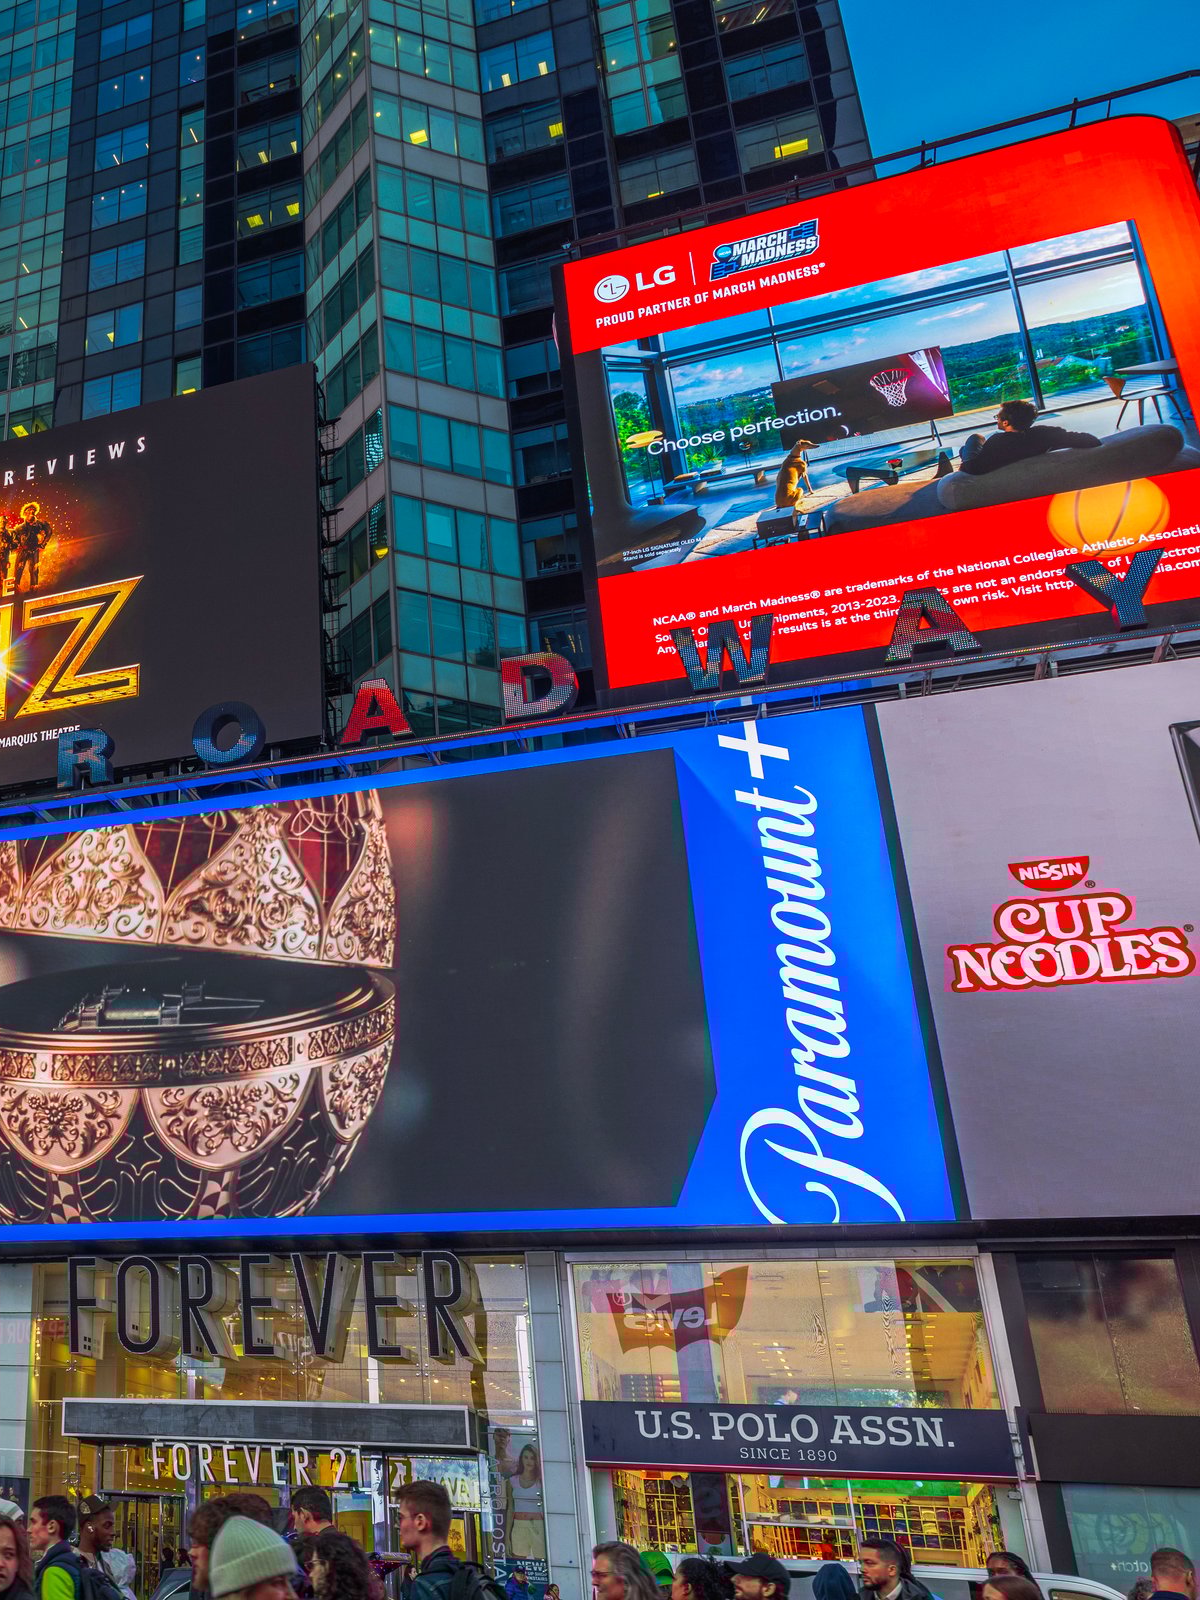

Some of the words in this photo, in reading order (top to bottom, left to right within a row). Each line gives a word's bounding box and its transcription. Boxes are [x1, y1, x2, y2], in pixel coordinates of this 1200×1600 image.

[732, 230, 788, 256] MARCH
[740, 236, 818, 267] MADNESS
[635, 265, 677, 291] LG
[595, 309, 635, 329] PROUD
[637, 296, 692, 322] PARTNER
[694, 292, 709, 305] OF
[712, 281, 757, 300] MARCH
[647, 428, 725, 456] Choose
[730, 405, 842, 442] perfection.
[698, 606, 719, 618] and
[721, 600, 758, 615] March
[823, 586, 843, 598] are
[845, 575, 914, 593] trademarks
[916, 569, 931, 581] of
[932, 567, 955, 578] the
[957, 555, 1011, 574] National
[1013, 546, 1079, 564] Collegiate
[1081, 536, 1135, 554] Athletic
[1137, 524, 1200, 544] Associati
[831, 594, 900, 614] 2013-2023.
[952, 585, 973, 594] are
[975, 579, 998, 590] not
[1000, 575, 1017, 585] an
[1107, 556, 1123, 568] of
[777, 620, 819, 636] results
[821, 618, 832, 628] is
[834, 617, 848, 627] at
[850, 612, 871, 625] the
[953, 595, 979, 607] own
[981, 589, 1010, 602] risk.
[1011, 584, 1042, 597] Visit
[1018, 861, 1083, 881] NISSIN
[996, 894, 1129, 944] CUP
[717, 697, 907, 1225] Paramount+
[950, 929, 1193, 990] NOODLES
[67, 1249, 478, 1363] FOREVER
[635, 1410, 702, 1440] U.S.
[709, 1410, 820, 1445] POLO
[828, 1414, 956, 1448] ASSN.
[150, 1441, 313, 1488] FOREVER
[328, 1446, 367, 1489] 21
[738, 1446, 791, 1462] SINCE
[796, 1448, 839, 1462] 1890
